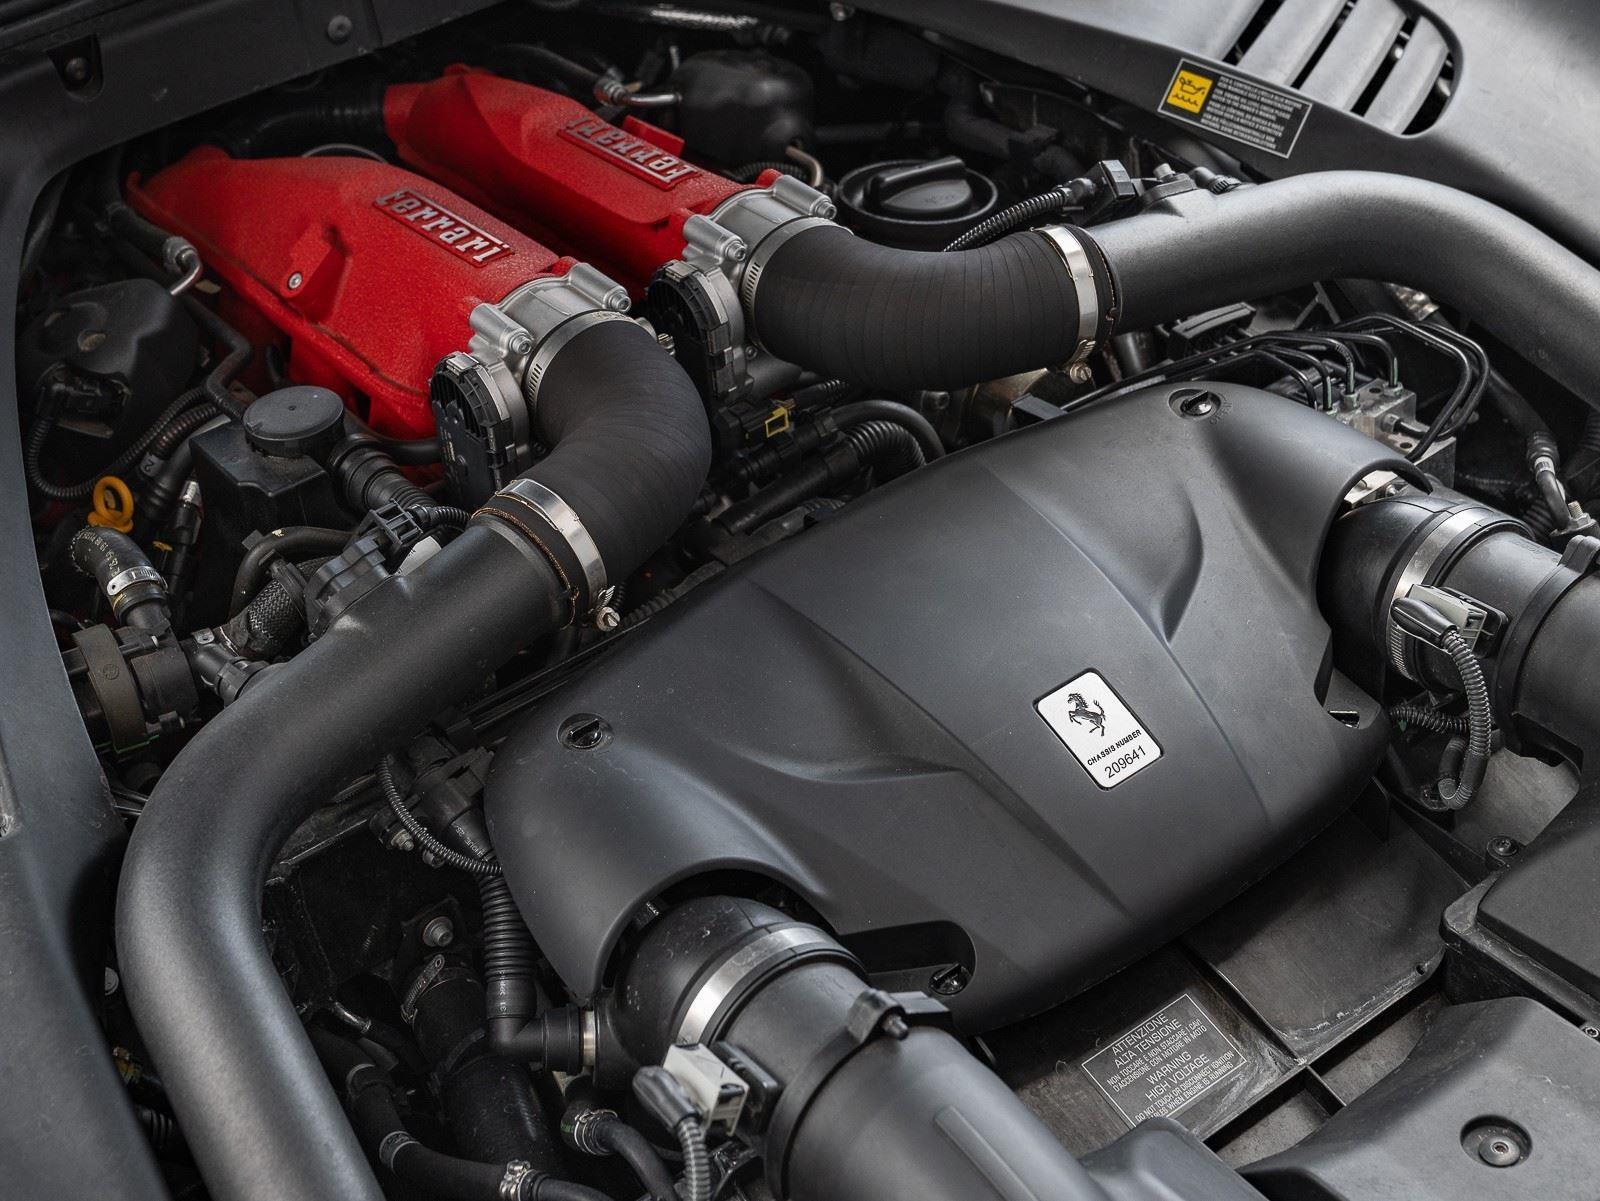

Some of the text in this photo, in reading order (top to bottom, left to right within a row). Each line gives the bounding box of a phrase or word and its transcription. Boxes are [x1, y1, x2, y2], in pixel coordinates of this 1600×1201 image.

[377, 188, 510, 263] Ferrari
[1087, 729, 1142, 766] CHASSIS NUMBER
[1105, 745, 1146, 778] 209641
[1106, 1073, 1121, 1086] NON
[1119, 1057, 1145, 1077] TOCCARE
[1146, 1046, 1162, 1058] NON
[1159, 1028, 1188, 1050] STACCARE
[1188, 1018, 1203, 1030] CAVI
[1109, 1012, 1168, 1055] ATTENZIONE
[1112, 1018, 1182, 1068] ALTA TENSIONE
[1112, 1024, 1208, 1092] D'ACCENSIONE CON MOTORE IN MOTO
[1144, 1053, 1210, 1101] HIGH VOLTAGE
[1145, 1050, 1192, 1085] WARNING
[1133, 1050, 1236, 1122] DO NOT TOUCH OR DISCONNECT IGNITION
[1165, 1094, 1185, 1109] WHEN
[1182, 1081, 1204, 1098] ENGINE
[1201, 1077, 1211, 1086] IS
[1207, 1061, 1234, 1081] RUNNING
